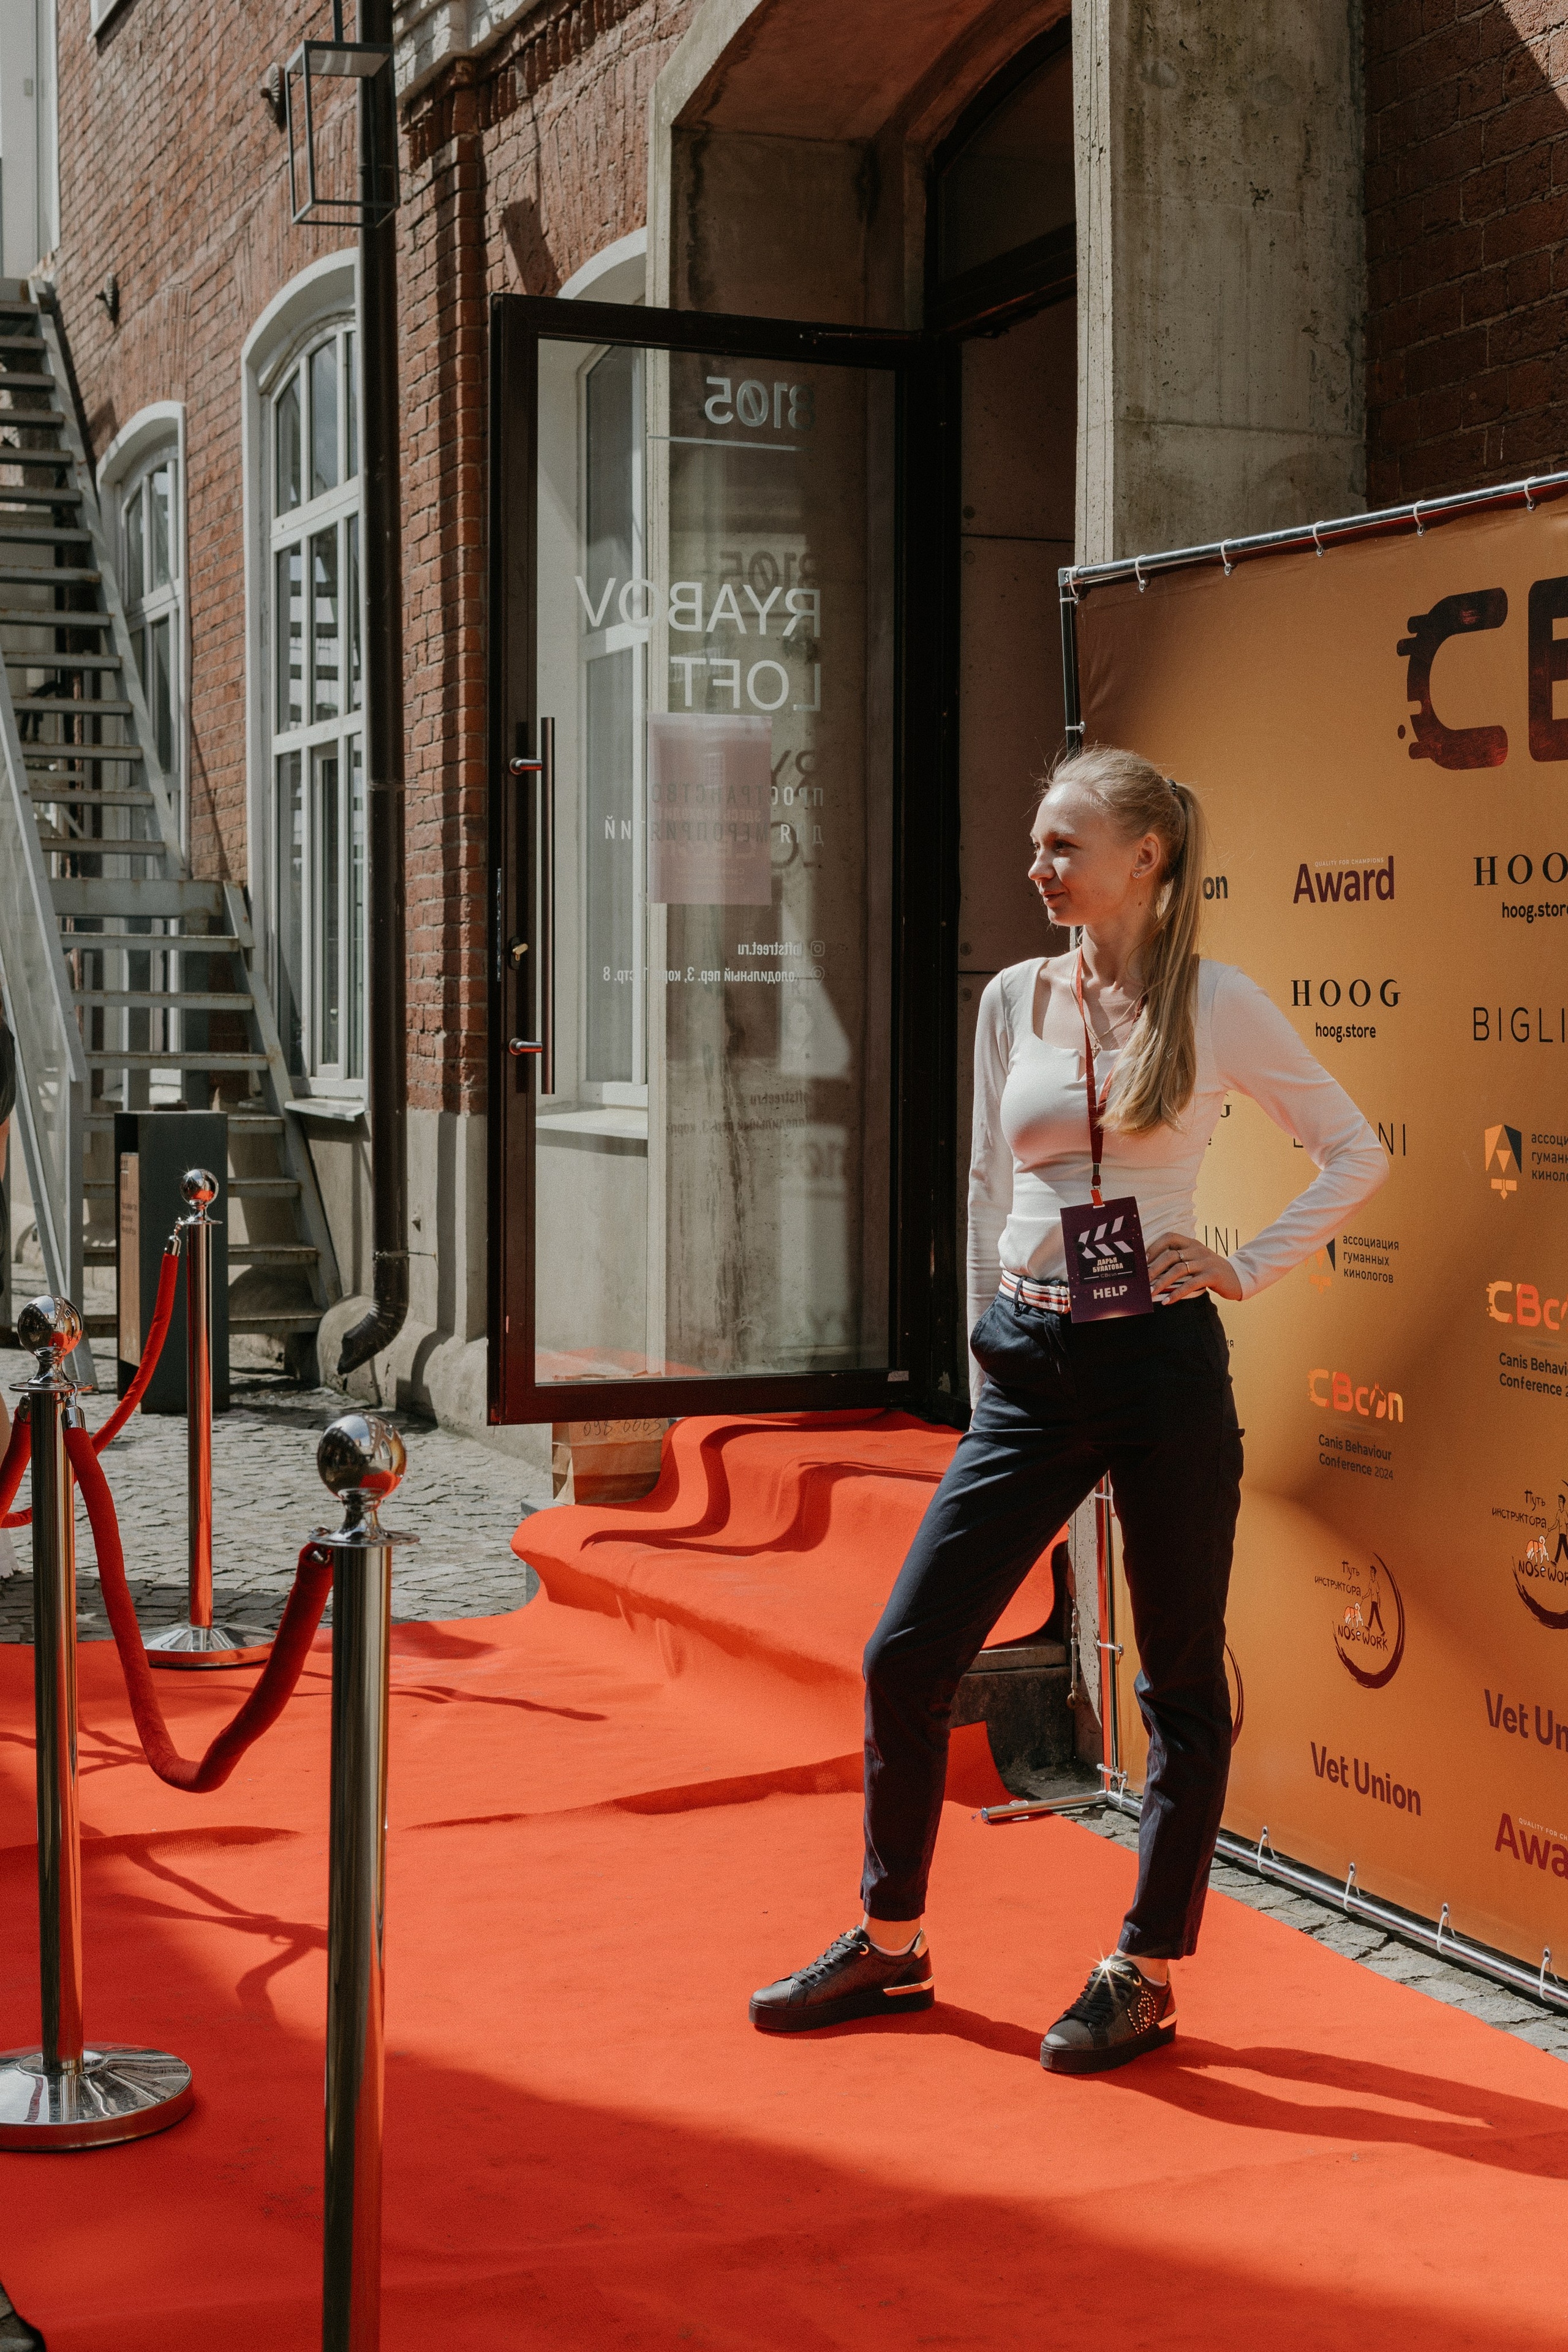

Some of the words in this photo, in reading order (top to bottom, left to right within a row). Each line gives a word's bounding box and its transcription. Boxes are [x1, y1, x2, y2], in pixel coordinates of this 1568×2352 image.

[1293, 855, 1395, 903] Award
[1502, 902, 1568, 924] hoog.stor
[1291, 979, 1401, 1007] HOOG
[1316, 1022, 1376, 1043] hoog.store
[1473, 1007, 1565, 1042] BIGLI
[1343, 1235, 1399, 1251] ассоциация
[1093, 1263, 1123, 1273] БУЛАТОВА
[1097, 1257, 1117, 1266] ДАРЬЯ
[1344, 1252, 1389, 1266] гуманных
[1344, 1268, 1393, 1283] кинологов
[1093, 1285, 1128, 1300] HELP
[1499, 1352, 1528, 1370] Canis
[1531, 1357, 1568, 1376] Behavi
[1499, 1373, 1562, 1396] Conference
[1319, 1434, 1343, 1450] Canis
[1346, 1440, 1392, 1461] Behaviour
[1319, 1453, 1372, 1476] Conference
[1374, 1467, 1393, 1480] 2024
[1484, 1689, 1528, 1738] Vet
[1310, 1741, 1349, 1789] Vet
[1354, 1758, 1421, 1816] Union
[1519, 1817, 1544, 1831] QUALITY
[1545, 1828, 1558, 1837] FOR
